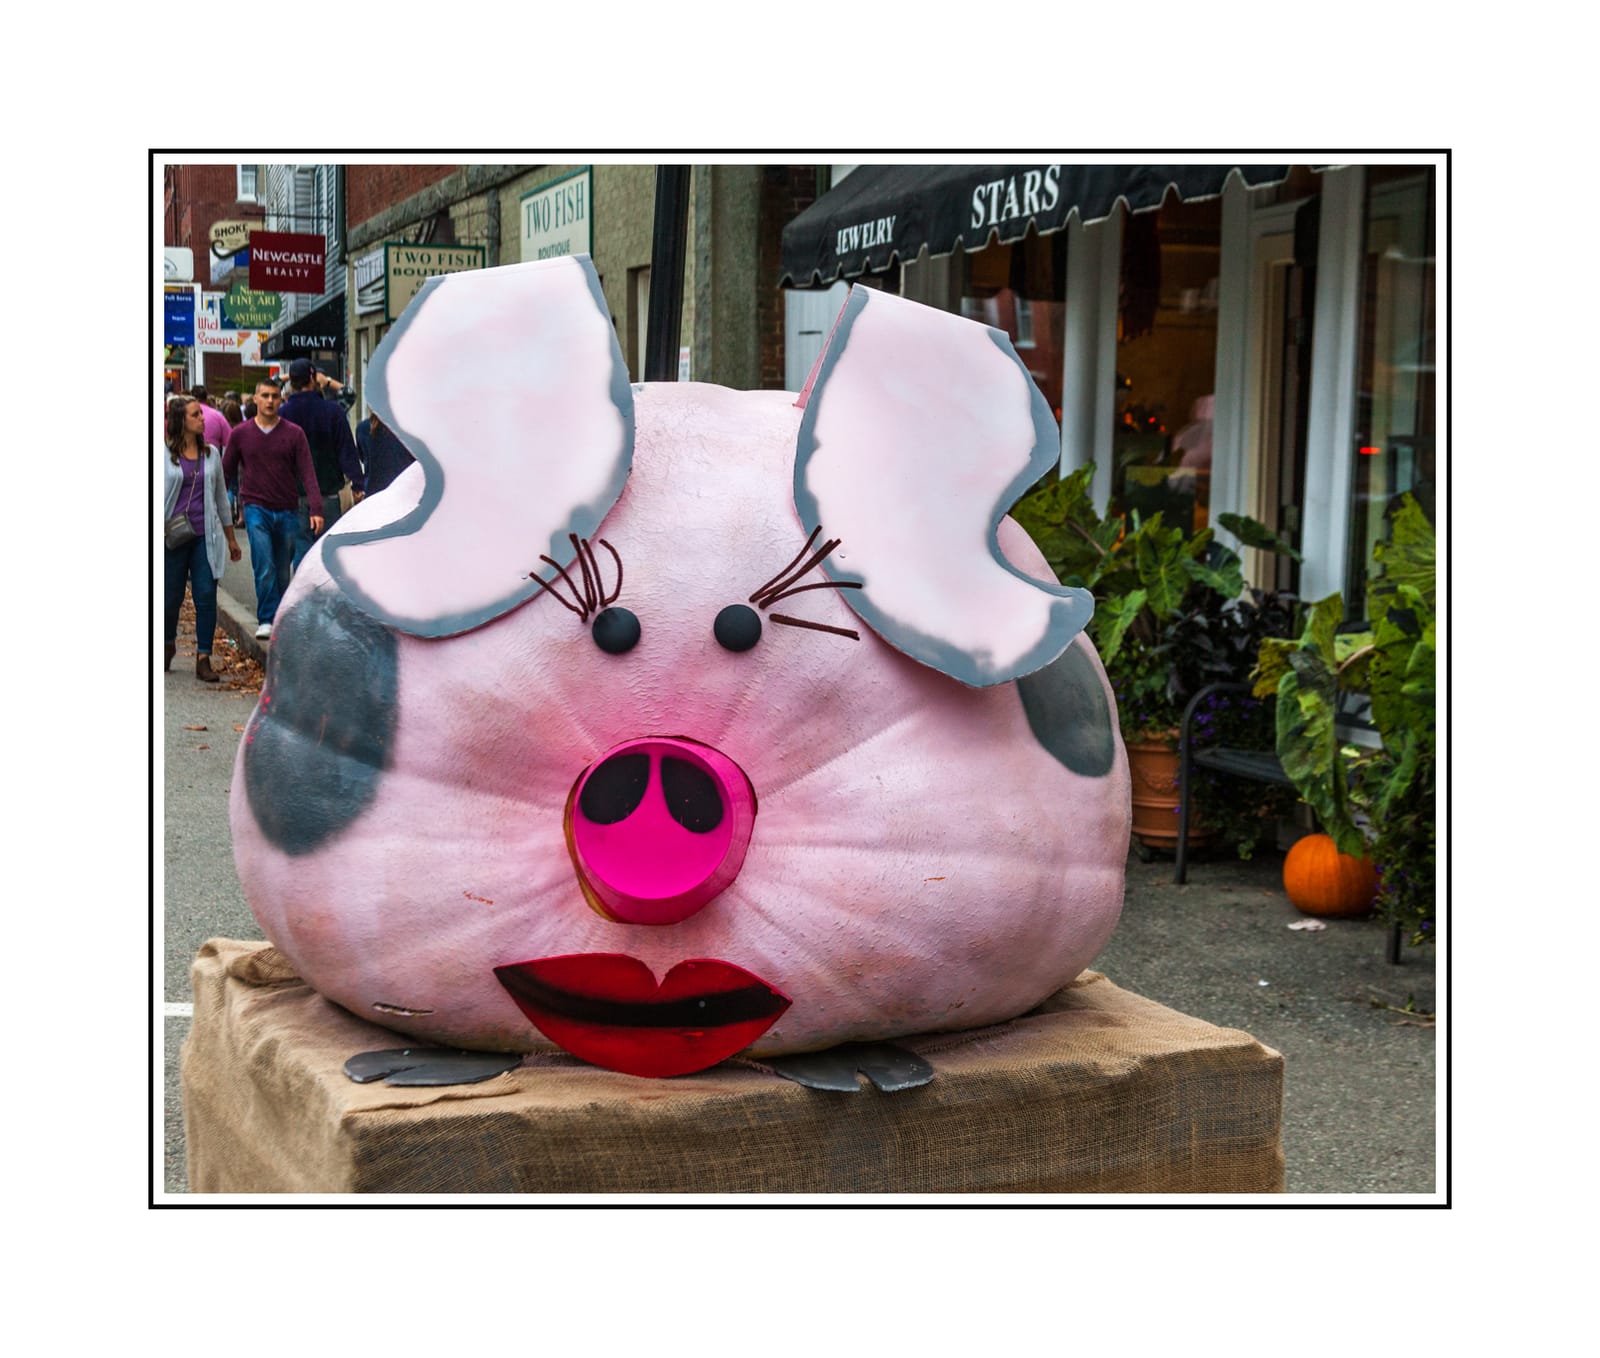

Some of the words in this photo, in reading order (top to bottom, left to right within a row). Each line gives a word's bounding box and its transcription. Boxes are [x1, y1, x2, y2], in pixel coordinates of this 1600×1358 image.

[971, 165, 1061, 229] STARS
[525, 195, 551, 239] TWO
[555, 181, 585, 229] FISH
[835, 215, 897, 256] JEWELRY
[253, 248, 322, 265] NEWCASTLE
[538, 239, 571, 260] BOUTIQUE
[393, 250, 431, 265] TWO
[438, 252, 477, 267] FISH
[266, 266, 310, 278] REALTY
[229, 295, 252, 306] FINE
[258, 295, 276, 306] ART
[235, 312, 274, 322] ANTIQUES
[197, 331, 236, 353] Scoops
[291, 335, 337, 348] REALTY
